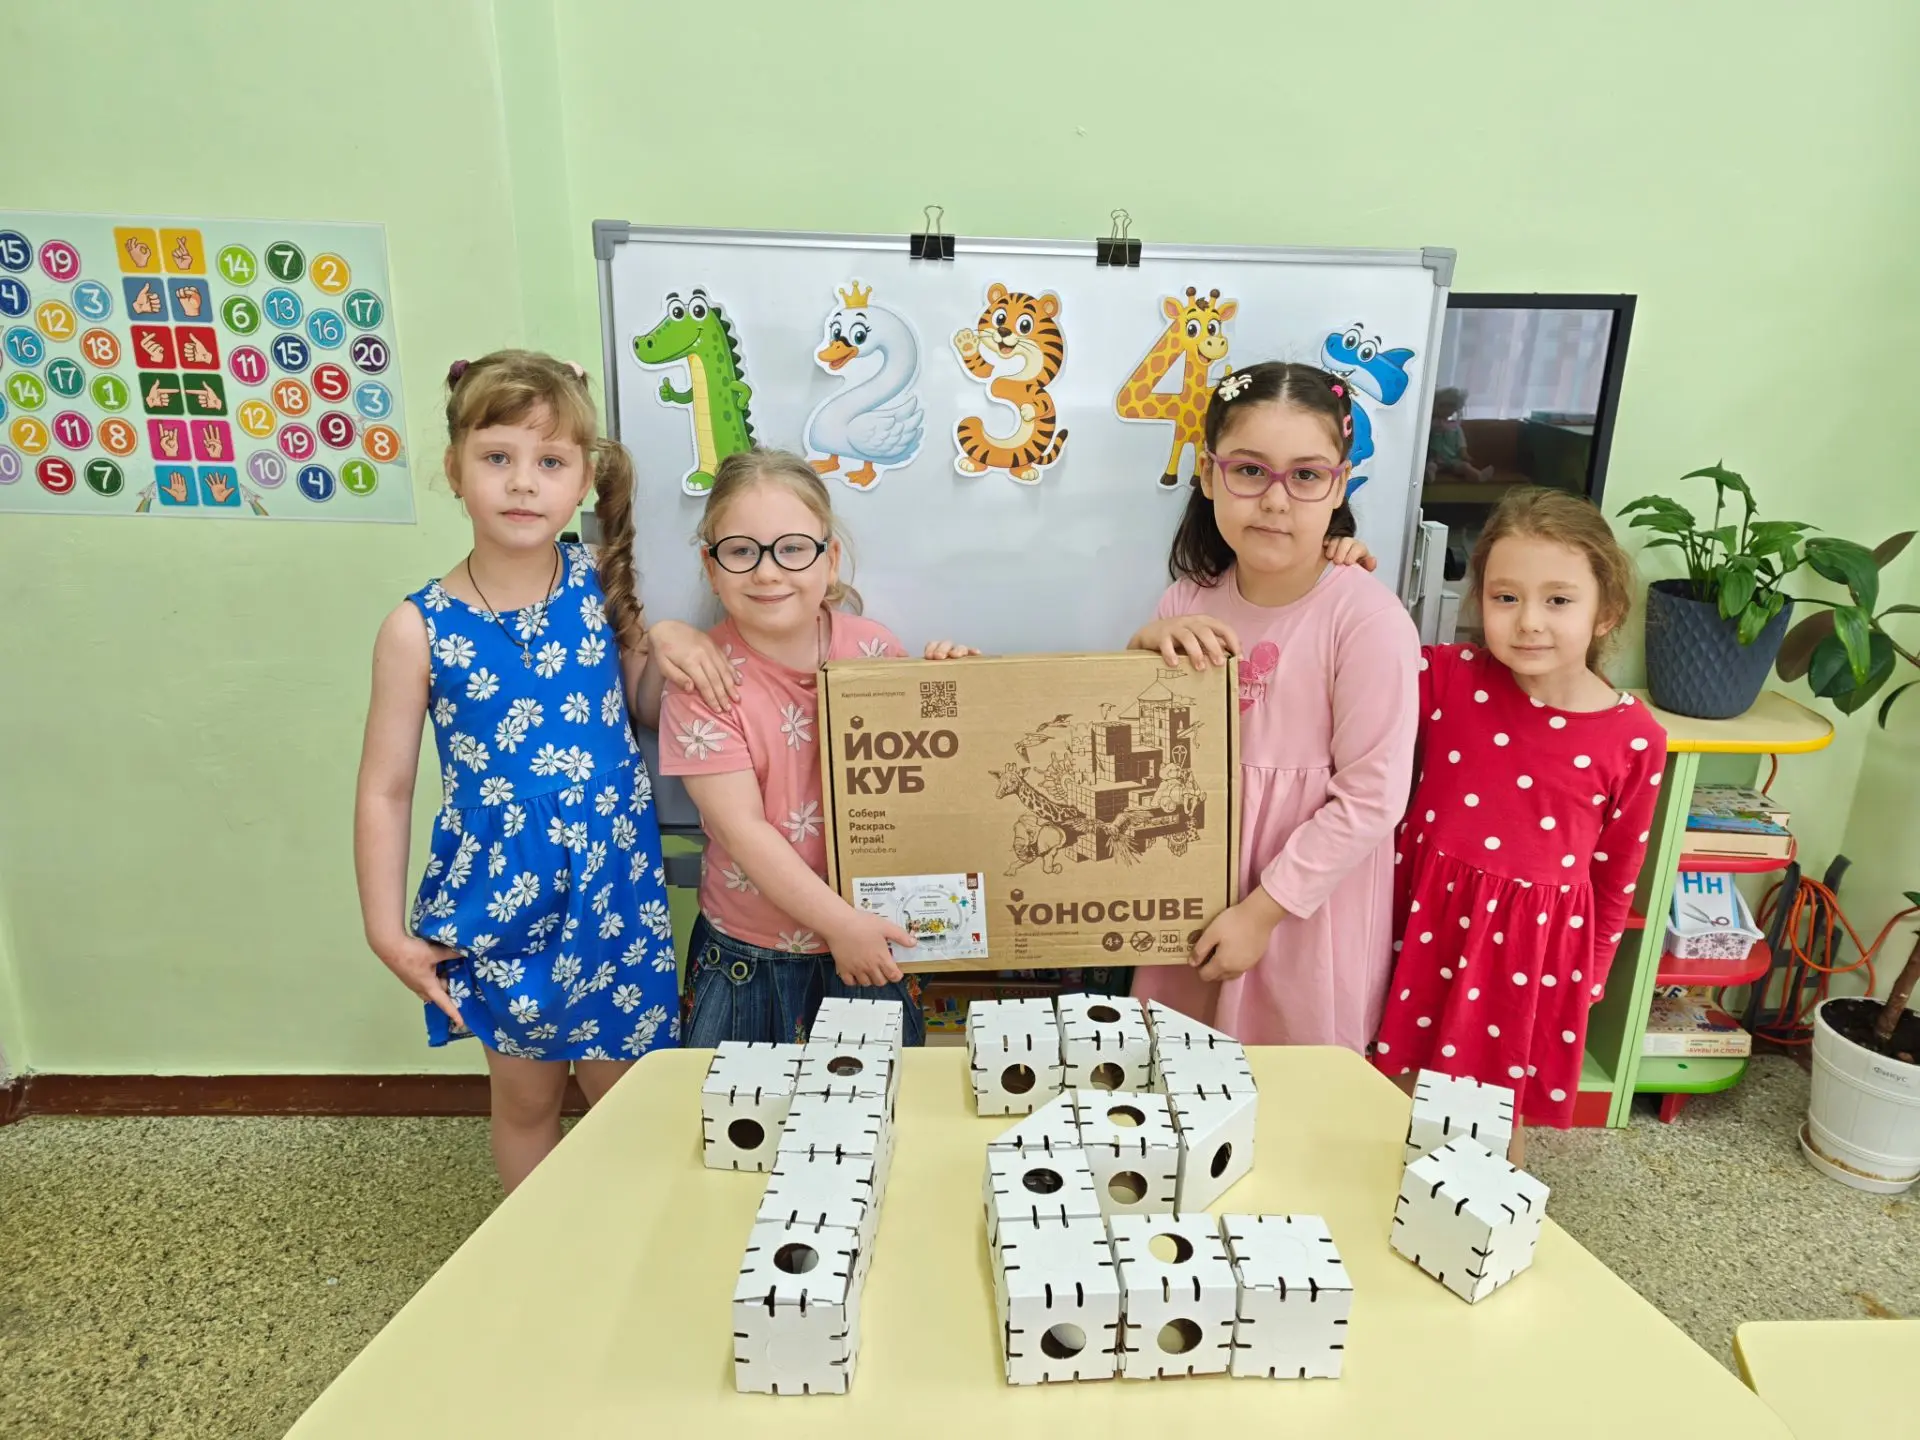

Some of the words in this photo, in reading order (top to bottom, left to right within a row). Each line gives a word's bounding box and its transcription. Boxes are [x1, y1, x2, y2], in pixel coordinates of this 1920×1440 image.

[45, 248, 72, 273] 19
[224, 253, 250, 278] 14
[275, 250, 294, 276] 7
[321, 261, 341, 287] 2
[2, 284, 18, 310] 4
[81, 288, 103, 314] 3
[270, 297, 296, 320] 13
[42, 309, 70, 333] 12
[231, 303, 250, 328] 6
[351, 299, 376, 322] 17
[313, 318, 338, 341] 16
[10, 335, 37, 358] 16
[86, 336, 114, 360] 18
[276, 341, 303, 365] 15
[355, 343, 386, 367] 20
[237, 353, 258, 377] 11
[52, 366, 76, 390] 17
[322, 370, 342, 395] 5
[13, 380, 39, 403] 14
[102, 381, 119, 406] 1
[278, 386, 303, 410] 18
[363, 388, 383, 413] 3
[60, 419, 82, 442] 11
[244, 407, 270, 430] 12
[328, 417, 346, 443] 9
[20, 423, 40, 447] 2
[109, 424, 127, 449] 8
[283, 431, 308, 454] 19
[373, 431, 390, 456] 8
[0, 453, 16, 475] 0
[46, 463, 67, 487] 5
[254, 458, 280, 480] 10
[93, 466, 112, 490] 7
[308, 471, 324, 496] 4
[352, 464, 367, 489] 1
[844, 715, 959, 760] ЙОХО
[846, 766, 925, 795] КУБ
[848, 809, 886, 819] Собери
[849, 822, 896, 832] Раскрась
[850, 834, 885, 844] Играй!
[1006, 889, 1204, 925] YOHOCUBE
[1105, 937, 1120, 946] 4+
[1162, 934, 1178, 944] 3D
